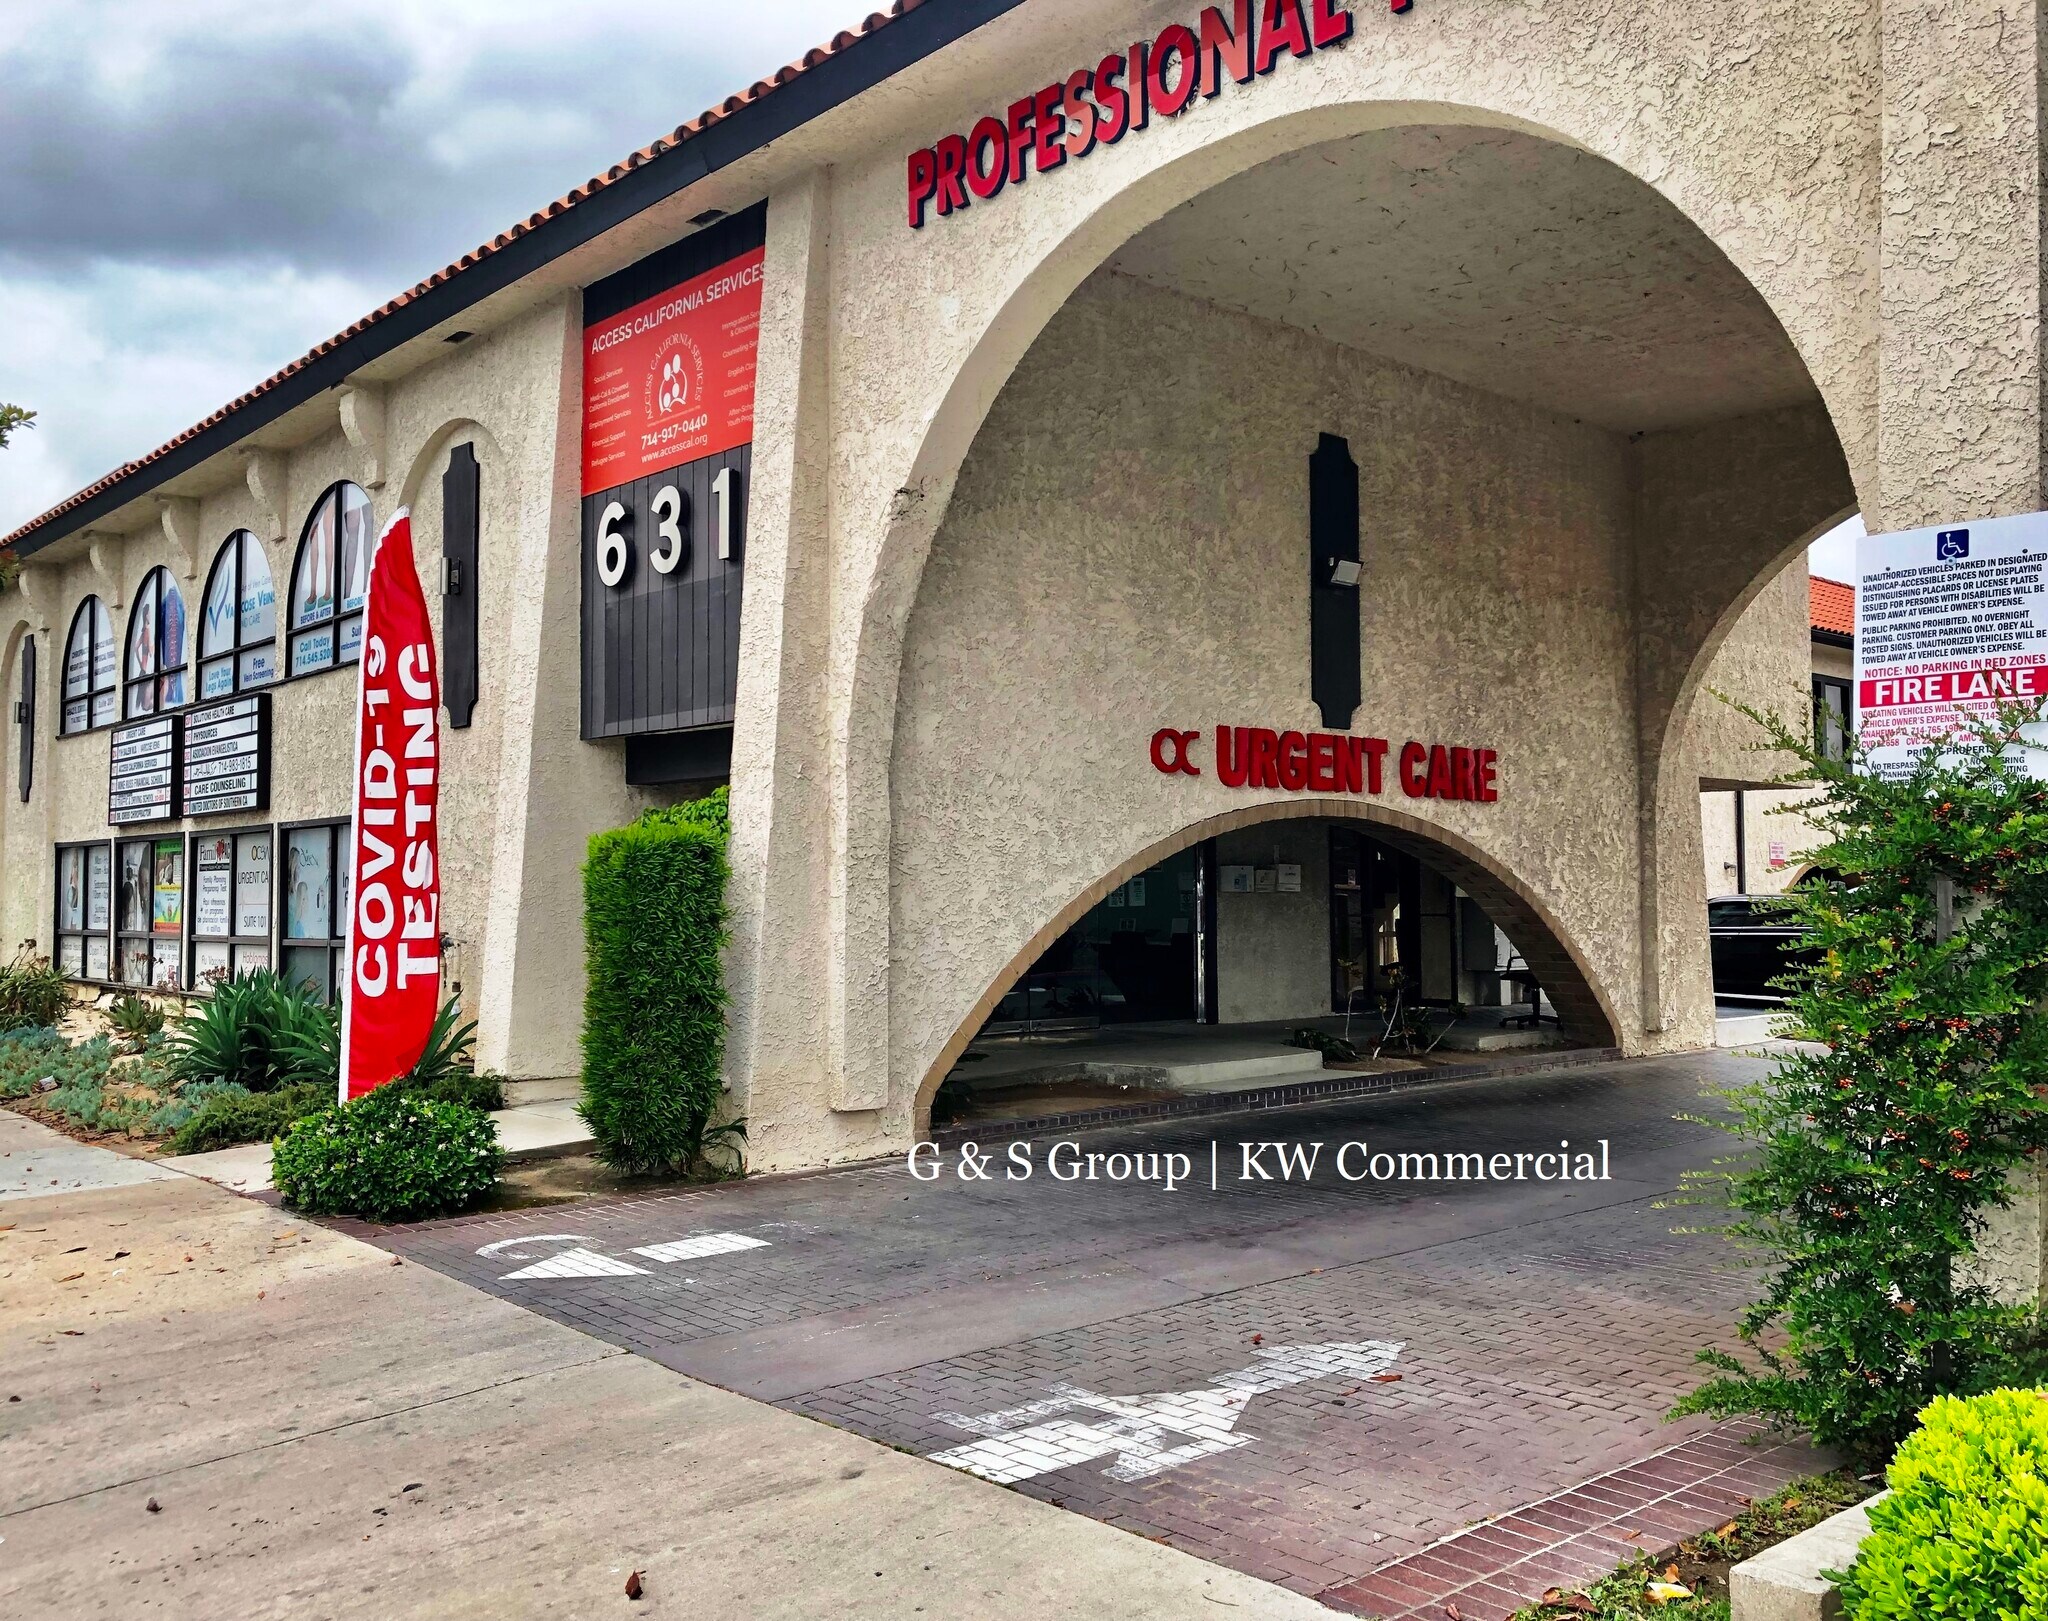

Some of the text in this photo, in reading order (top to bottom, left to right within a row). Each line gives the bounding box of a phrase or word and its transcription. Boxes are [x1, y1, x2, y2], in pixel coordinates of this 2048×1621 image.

[908, 0, 1353, 228] PROFESSIONAL
[592, 262, 765, 354] ACCESS CALIFORNIA SERVICES
[645, 374, 654, 420] ACCESS
[650, 333, 692, 370] CALIFORNIA
[691, 344, 704, 402] SERVICES
[641, 414, 708, 450] 714-917-0440
[641, 434, 708, 463] www.accesscal.org
[597, 467, 735, 587] 631
[1863, 553, 2048, 583] UNAUTHORIZED VEHICLES PARKED IN DESIGNATED
[1863, 564, 2042, 592] HANDICAP-ACCESSIBLE SPACES NOT DISPLAYING
[1863, 574, 2038, 602] DISTINGUISHING PLACARDS OR LICENSE PLATES
[1863, 584, 2044, 612] ISSUED FOR PERSONS WITH DISABILITIES WILL BE
[1862, 597, 2025, 622] TOWED AWAY AT VEHICLE OWNER'S EXPENSE.
[1862, 610, 2030, 635] PUBLIC PARKING PROHIBITED. NO OVERNIGHT
[1862, 620, 2034, 645] PARKING. CUSTOMER PARKING ONLY. OBEY ALL
[300, 638, 312, 652] Call
[313, 636, 330, 648] Today
[1862, 630, 2046, 654] POSTED SIGNS. UNAUTHORIZED VEHICLES WILL BE
[1862, 655, 1886, 664] TOWED
[1887, 653, 1906, 662] AWAY
[1918, 648, 1948, 658] VEHICLE
[1950, 645, 1986, 656] OWNER'S
[1988, 642, 2024, 653] EXPENSE.
[252, 658, 265, 670] Free
[252, 668, 274, 680] Screening
[1864, 654, 2046, 679] NOTICE: NO PARKING IN RED ZONES
[1876, 669, 2035, 705] FIRE LANE
[194, 706, 234, 724] SOLUTIONS HEALTH CARE
[1892, 716, 1924, 726] OWNER'S
[1898, 706, 1934, 716] VEHICLES
[1935, 702, 1952, 713] WILL
[1966, 702, 1988, 711] CITED
[194, 728, 218, 740] PHYSOURCES
[1958, 734, 1976, 742] AMC
[1946, 745, 1993, 756] PROPERT
[1215, 725, 1388, 794] URGENT
[1400, 741, 1498, 802] CARE
[1884, 762, 1927, 770] TRESPASS
[194, 778, 246, 796] CARE COUNSELING
[202, 800, 218, 812] DOCTORS
[224, 796, 242, 808] SOUTHERN
[397, 643, 440, 990] TESTING
[238, 870, 260, 884] URGENT
[244, 916, 256, 928] SUITE
